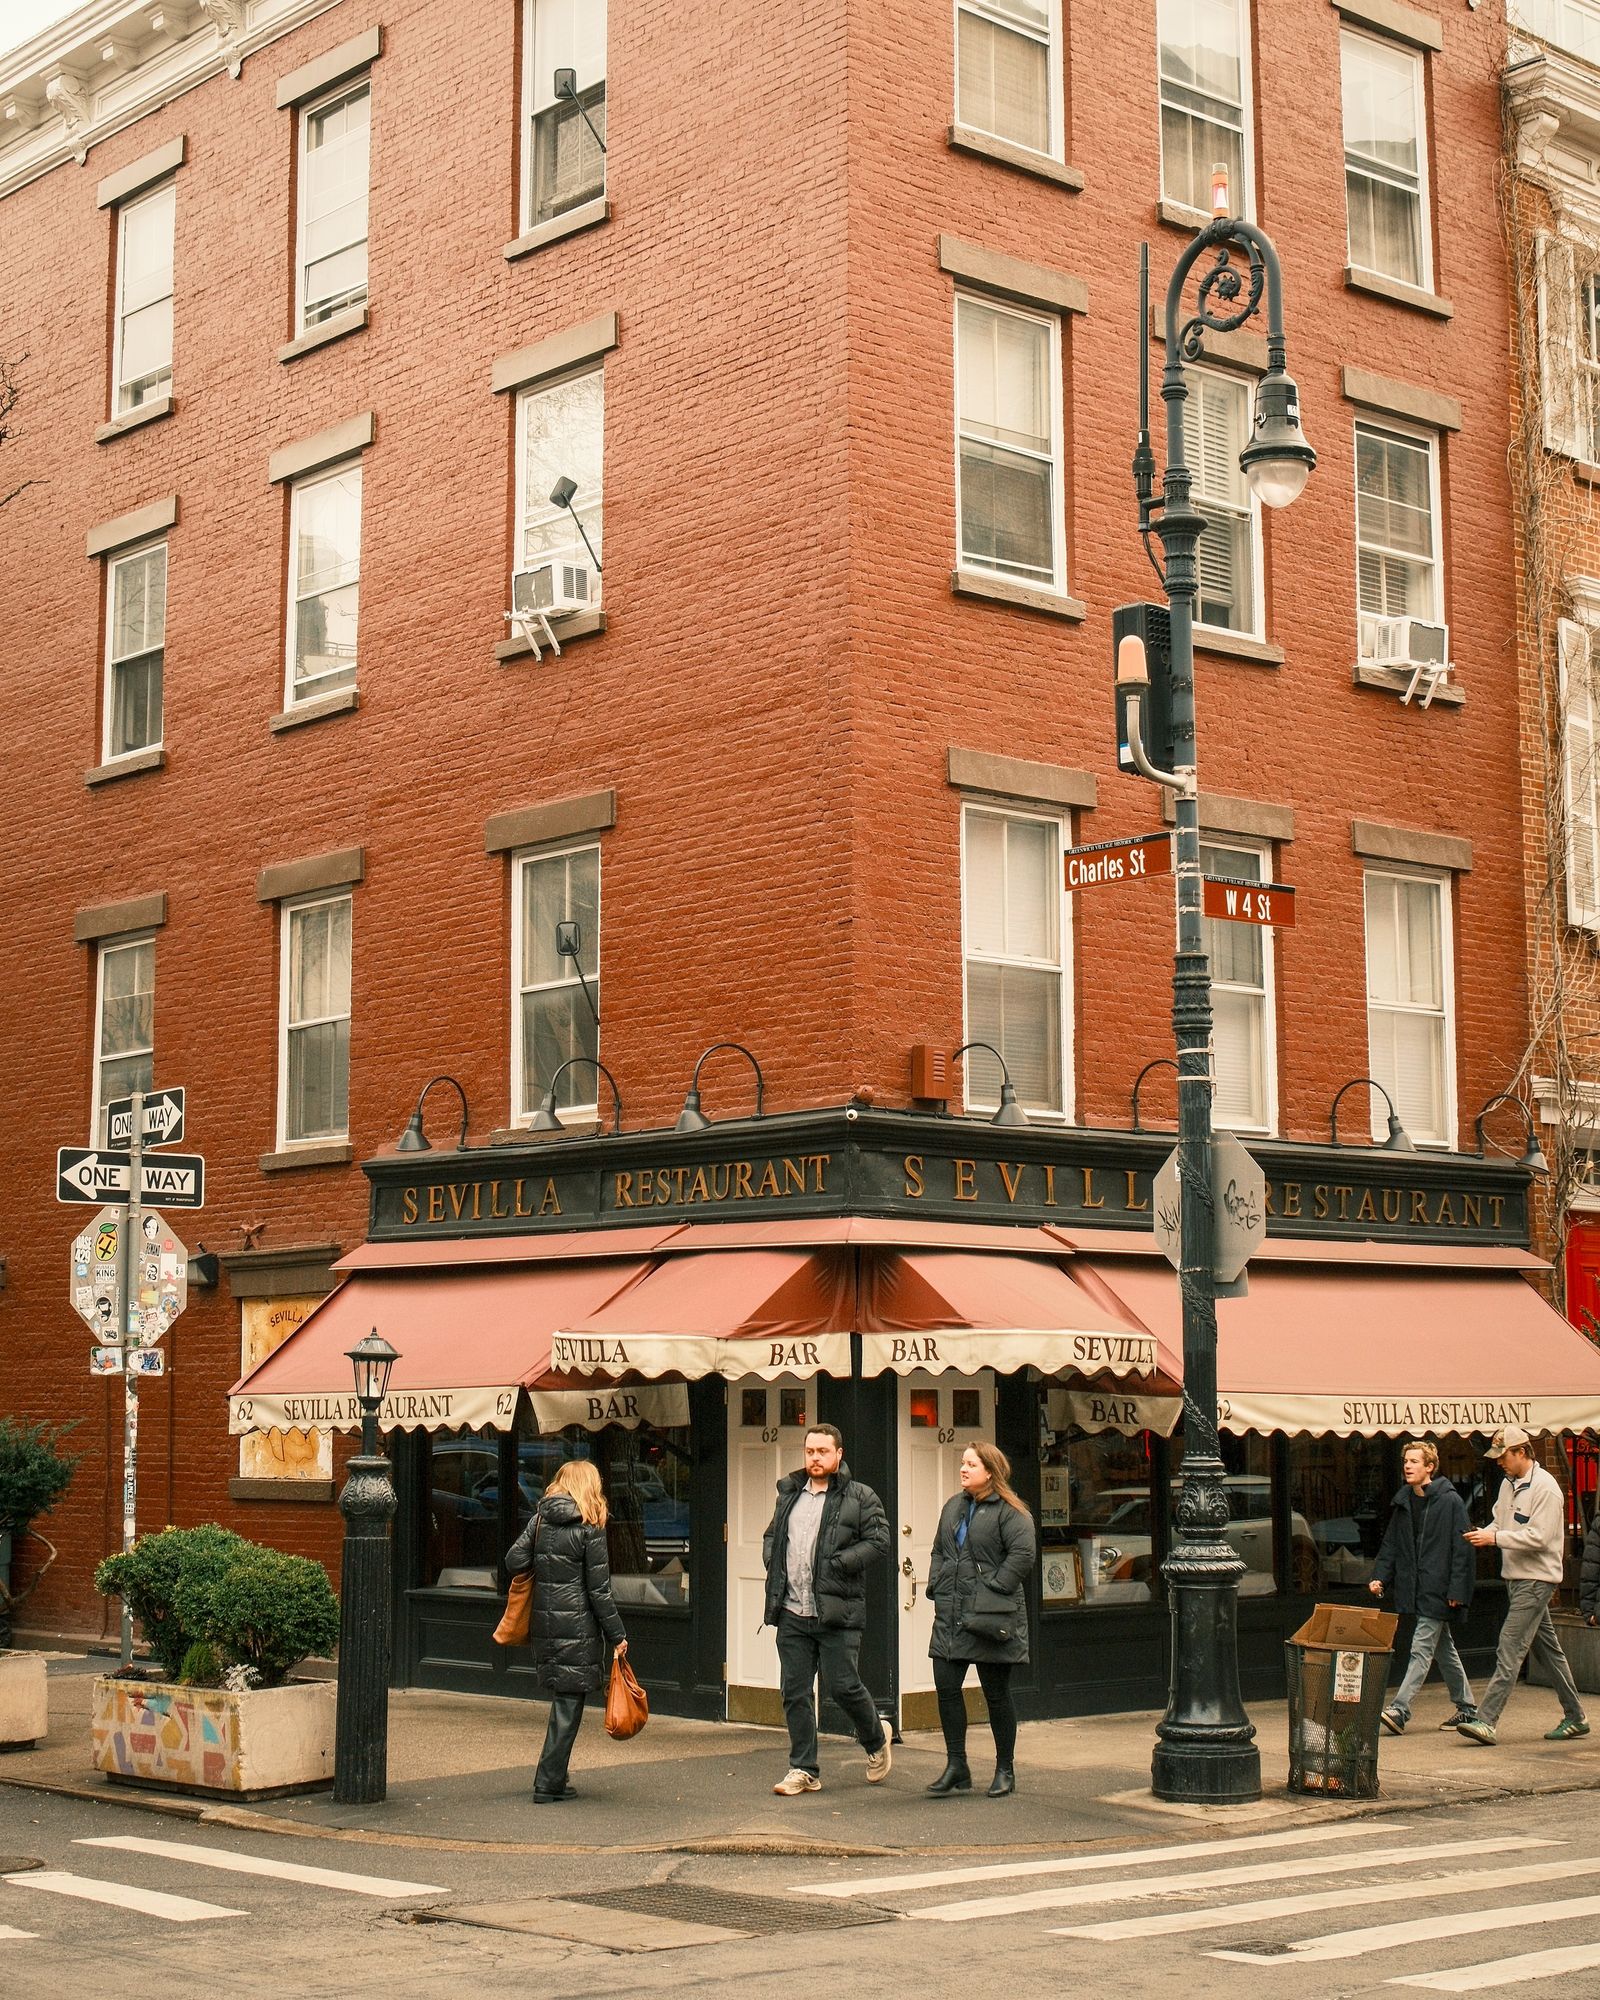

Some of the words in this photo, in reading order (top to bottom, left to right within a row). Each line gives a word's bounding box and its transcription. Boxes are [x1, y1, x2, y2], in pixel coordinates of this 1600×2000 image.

[1069, 855, 1124, 886] Charles
[1129, 848, 1146, 876] St
[1225, 889, 1237, 916] W
[1242, 892, 1252, 918] 4
[1257, 894, 1271, 921] St
[148, 1106, 173, 1130] WAY
[78, 1166, 121, 1188] ONE
[145, 1169, 190, 1191] WAY
[403, 1177, 563, 1225] SEVILLA
[614, 1153, 832, 1209] RESTAURANT
[903, 1154, 1149, 1211] SEVILL
[96, 1269, 116, 1278] KING
[270, 1309, 304, 1328] SEVILLA
[554, 1336, 631, 1364] SEVILLA
[768, 1341, 821, 1368] BAR
[890, 1338, 941, 1363] BAR
[1073, 1335, 1154, 1364] SEVILLA
[237, 1400, 254, 1421] 62
[284, 1397, 344, 1421] SEVILLA
[496, 1392, 513, 1416] 62
[586, 1394, 641, 1421] BAR
[1090, 1399, 1140, 1425] BAR
[1342, 1401, 1416, 1426] SEVILLA
[1419, 1402, 1532, 1426] RESTAURANT
[761, 1426, 779, 1443] 62
[937, 1427, 956, 1444] 62
